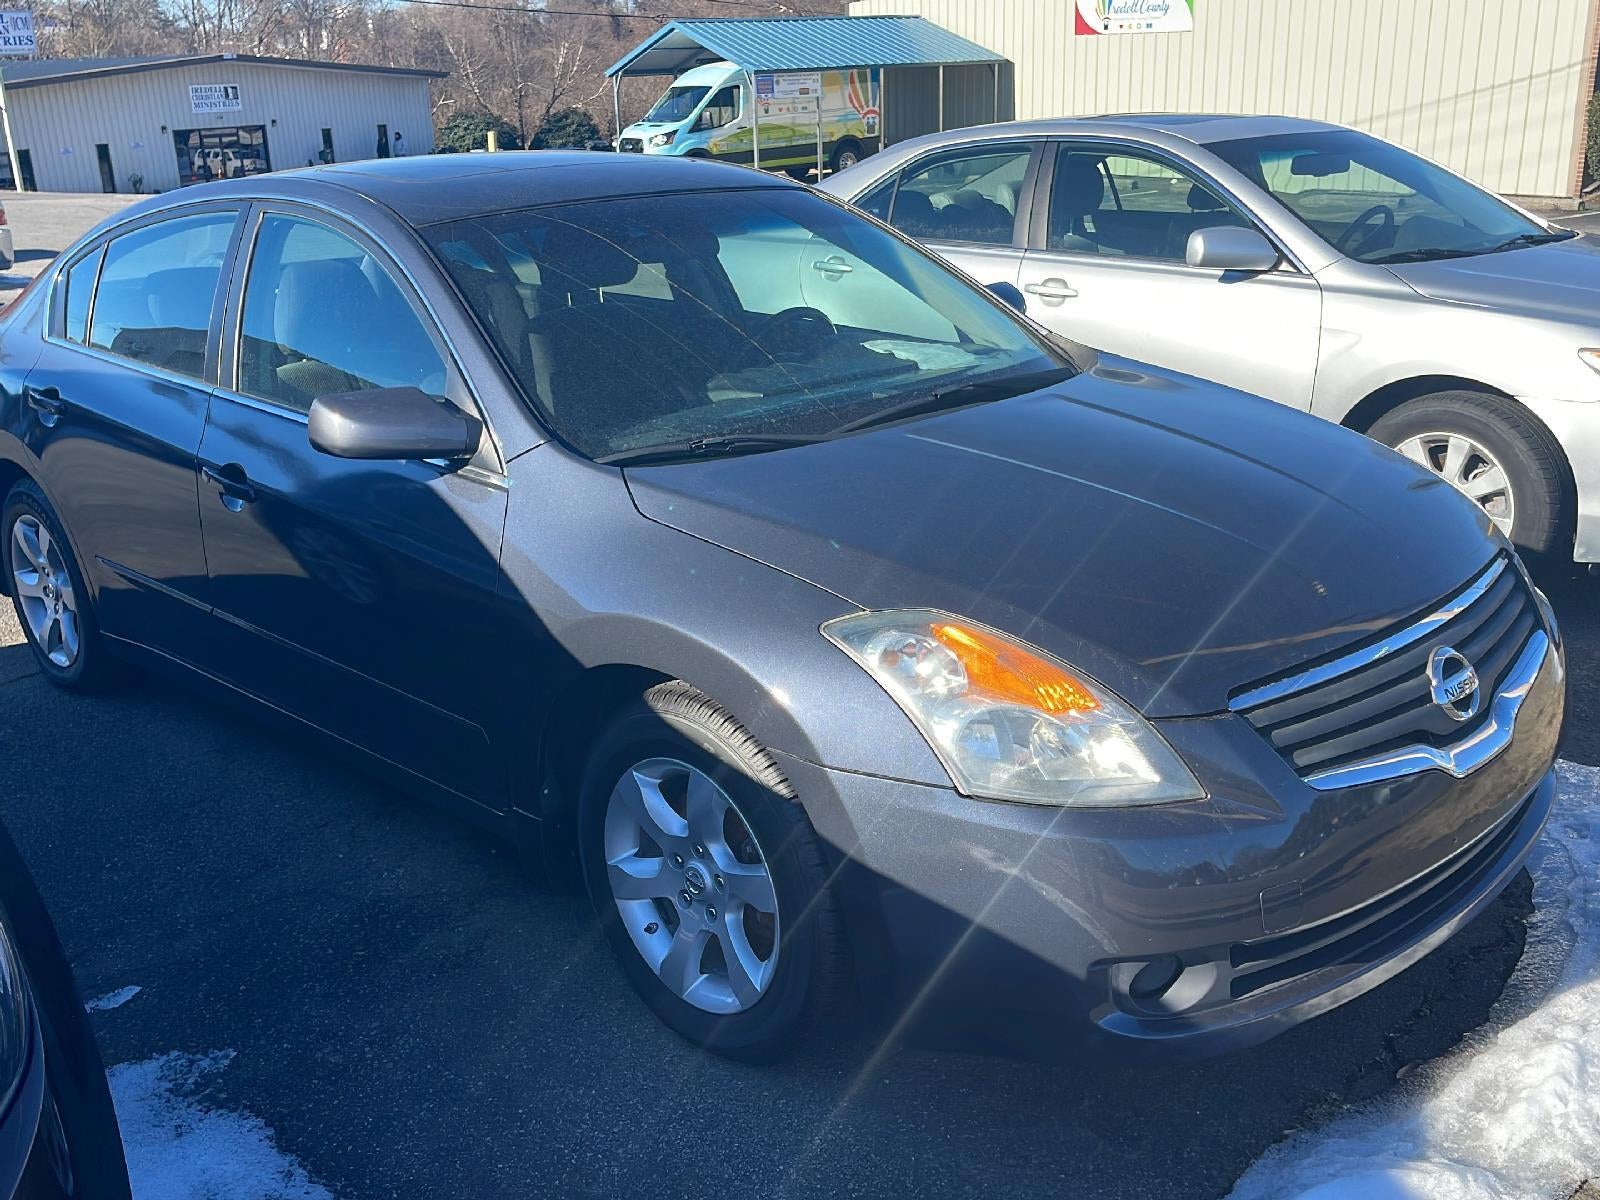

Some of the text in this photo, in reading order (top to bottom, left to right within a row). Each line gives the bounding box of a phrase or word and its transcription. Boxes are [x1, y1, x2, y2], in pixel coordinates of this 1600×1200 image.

[1139, 0, 1169, 16] County
[193, 100, 240, 109] MINISTRIES
[1444, 671, 1478, 699] NISSA
